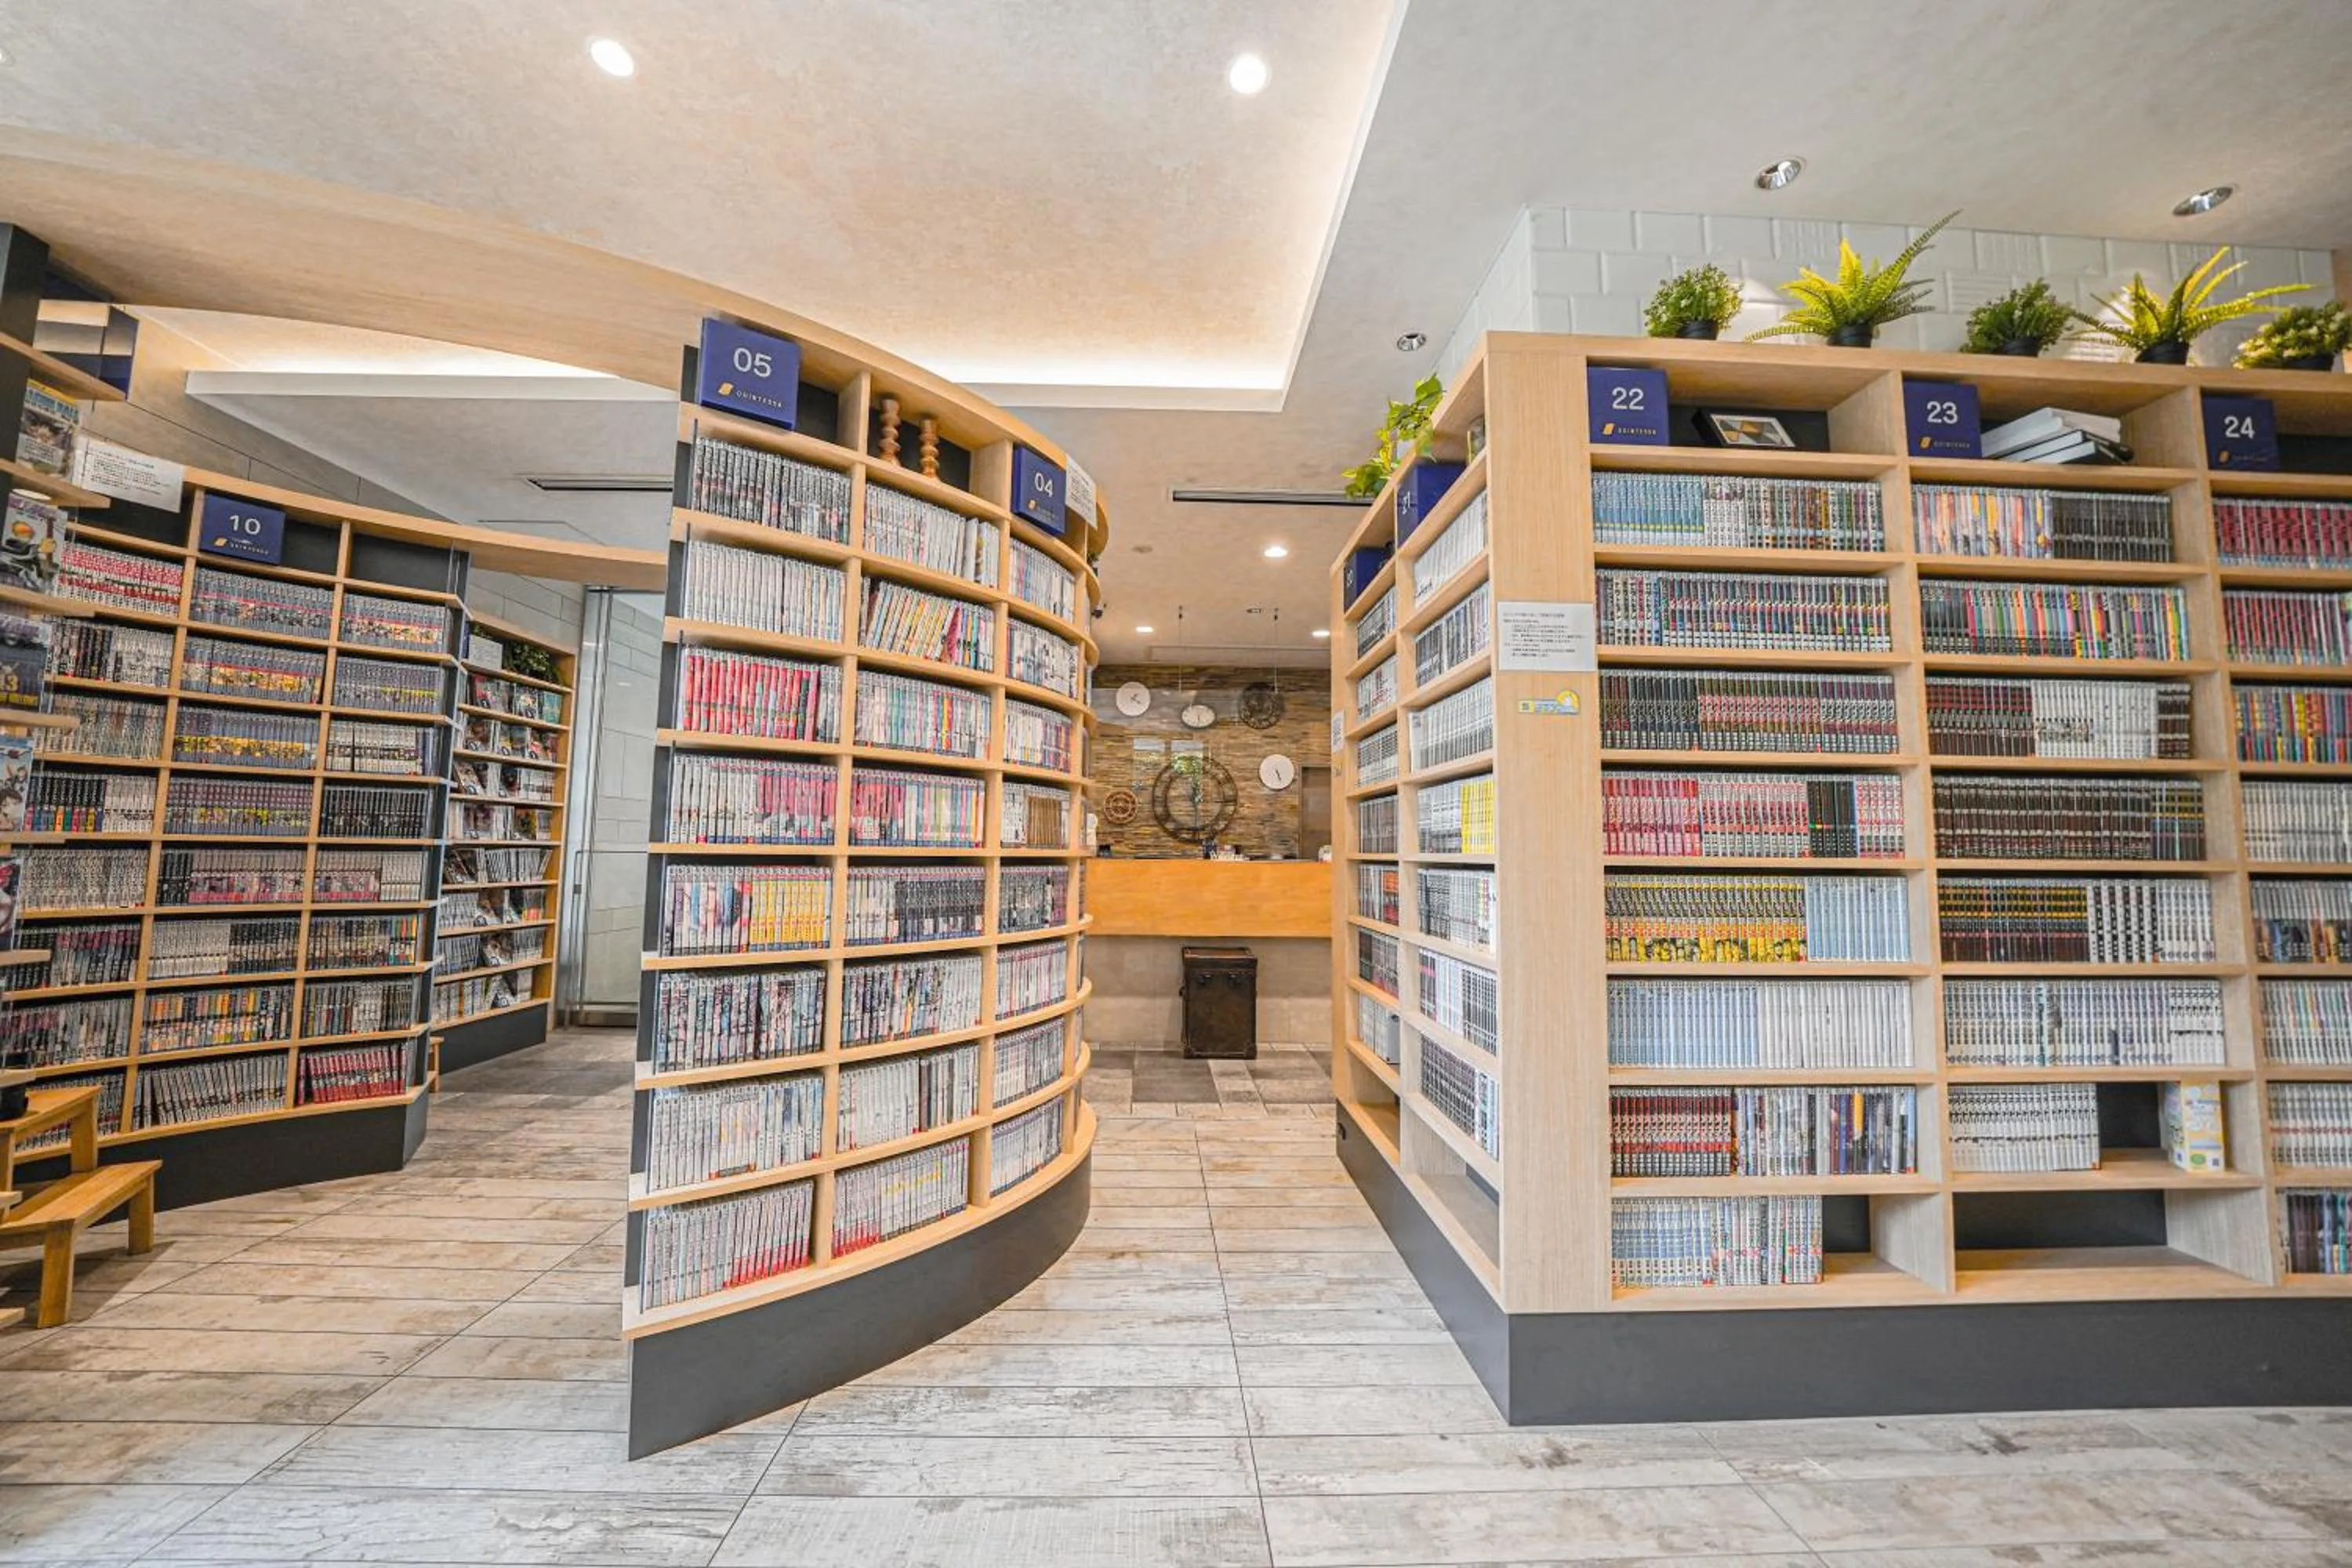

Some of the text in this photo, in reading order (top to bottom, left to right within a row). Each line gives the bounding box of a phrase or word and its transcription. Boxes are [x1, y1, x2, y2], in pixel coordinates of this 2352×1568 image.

[734, 347, 772, 378] 05
[1612, 387, 1644, 410] 22
[1926, 401, 1958, 424] 23
[2223, 416, 2256, 439] 24
[1035, 472, 1054, 498] 04
[230, 515, 261, 535] 10
